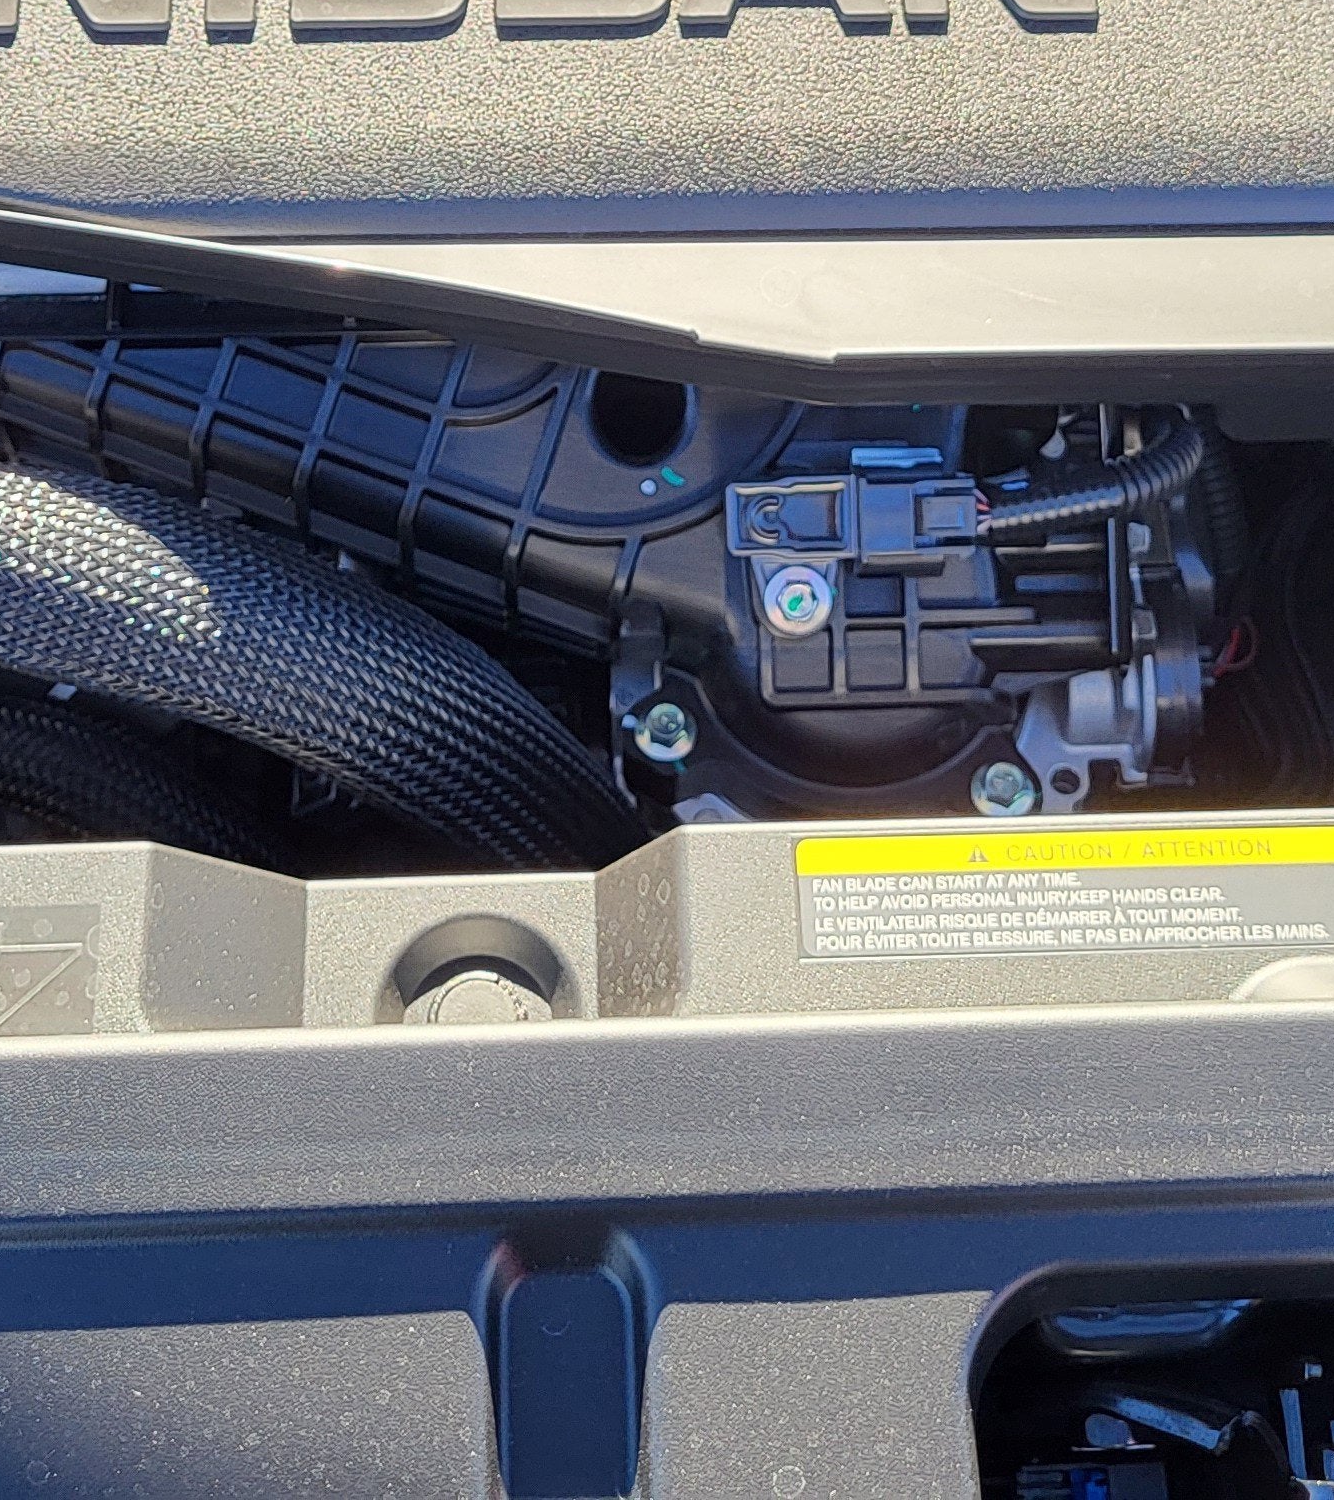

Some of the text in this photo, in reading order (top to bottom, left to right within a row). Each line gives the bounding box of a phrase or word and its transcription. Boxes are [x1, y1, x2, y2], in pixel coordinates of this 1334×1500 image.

[1006, 842, 1113, 862] CAUTION
[1142, 839, 1272, 859] ATTENTION
[812, 872, 1082, 894] FAN BLADE CAN START AT ANY TIME.
[813, 896, 838, 912] TO
[838, 895, 879, 912] HELP
[881, 894, 932, 910] AVOID
[932, 892, 1015, 909] PERSONAL
[1112, 888, 1168, 904] HANDS
[1170, 886, 1227, 902] CLEAR.
[815, 916, 835, 932] LE
[837, 914, 938, 932] VENTILATEUR
[939, 912, 999, 930] RISQUE
[1001, 912, 1024, 927] DE
[1026, 908, 1112, 927] DÉMARRER
[1128, 909, 1170, 924] TOUT
[1171, 906, 1244, 924] MOMENT.
[817, 922, 1331, 951] POUR ÉVITER TOUTE BLESSURE, NE PAS EN APPROCHER LES MAINS.
